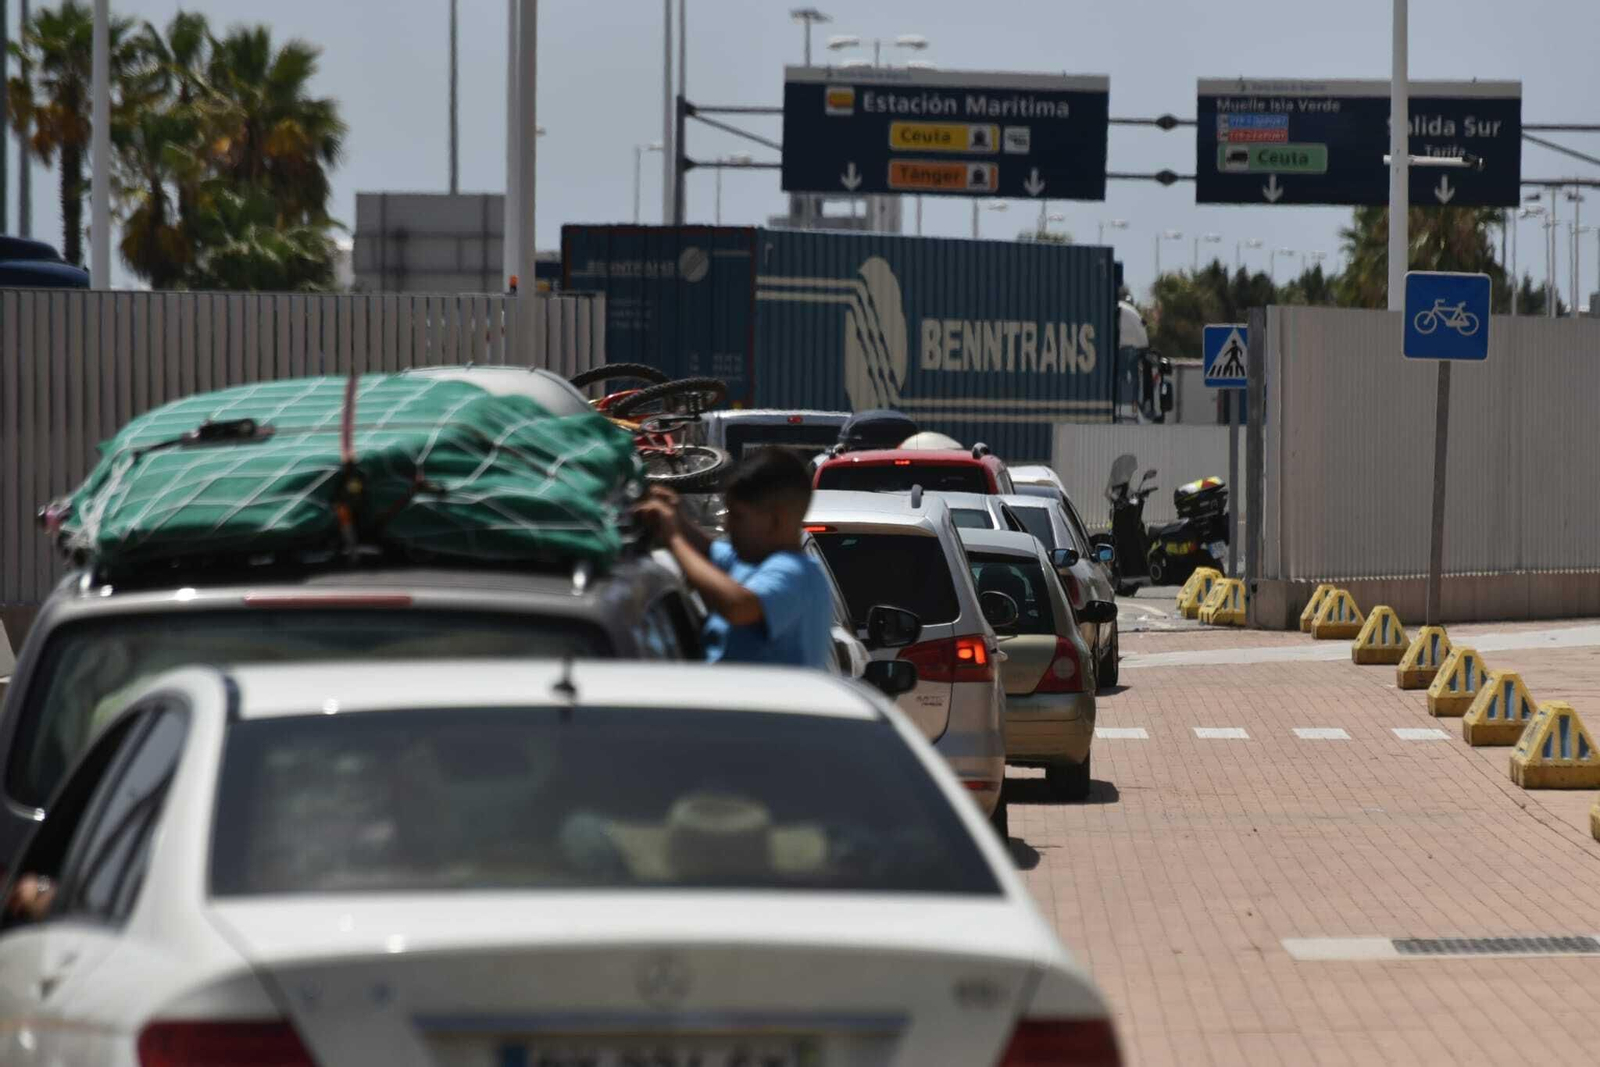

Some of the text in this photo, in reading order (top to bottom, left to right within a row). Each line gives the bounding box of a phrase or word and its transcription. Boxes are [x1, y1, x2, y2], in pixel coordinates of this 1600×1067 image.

[862, 90, 1070, 118] Estación Marítima
[1216, 97, 1341, 114] Muelle Isla Verde
[900, 127, 952, 143] Ceuta
[1463, 115, 1501, 138] Sur
[1257, 148, 1309, 167] Ceuta
[920, 318, 1097, 374] BENNTRANS
